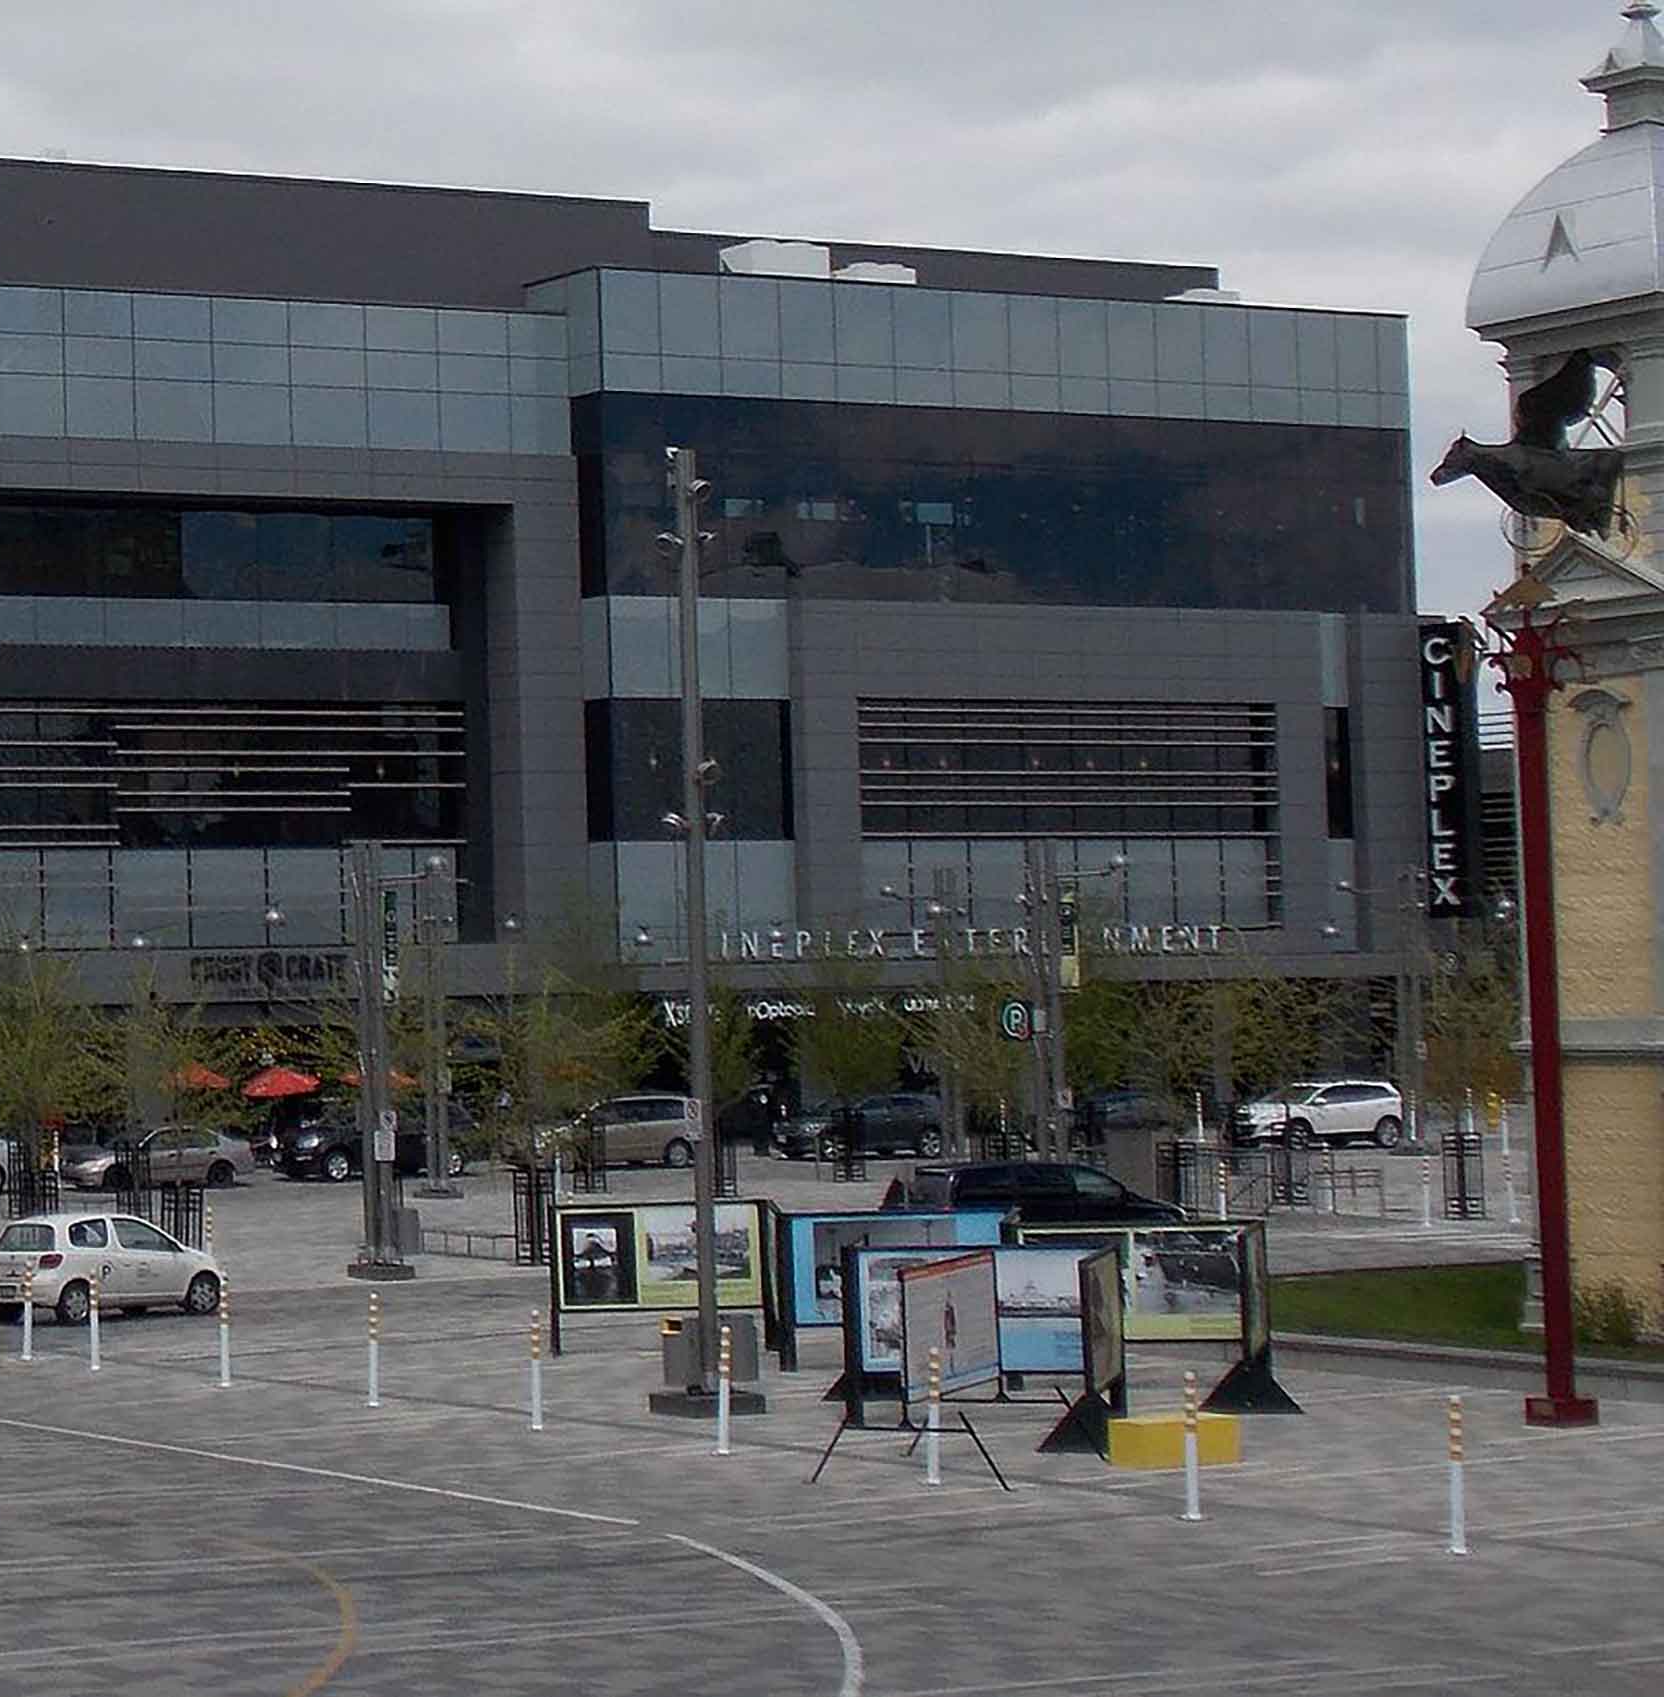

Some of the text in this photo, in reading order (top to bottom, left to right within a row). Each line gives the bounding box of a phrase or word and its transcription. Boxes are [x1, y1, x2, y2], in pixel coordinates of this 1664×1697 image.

[1424, 637, 1462, 906] CINEPLEX
[719, 925, 1222, 958] INEPLEX ETERNMENT
